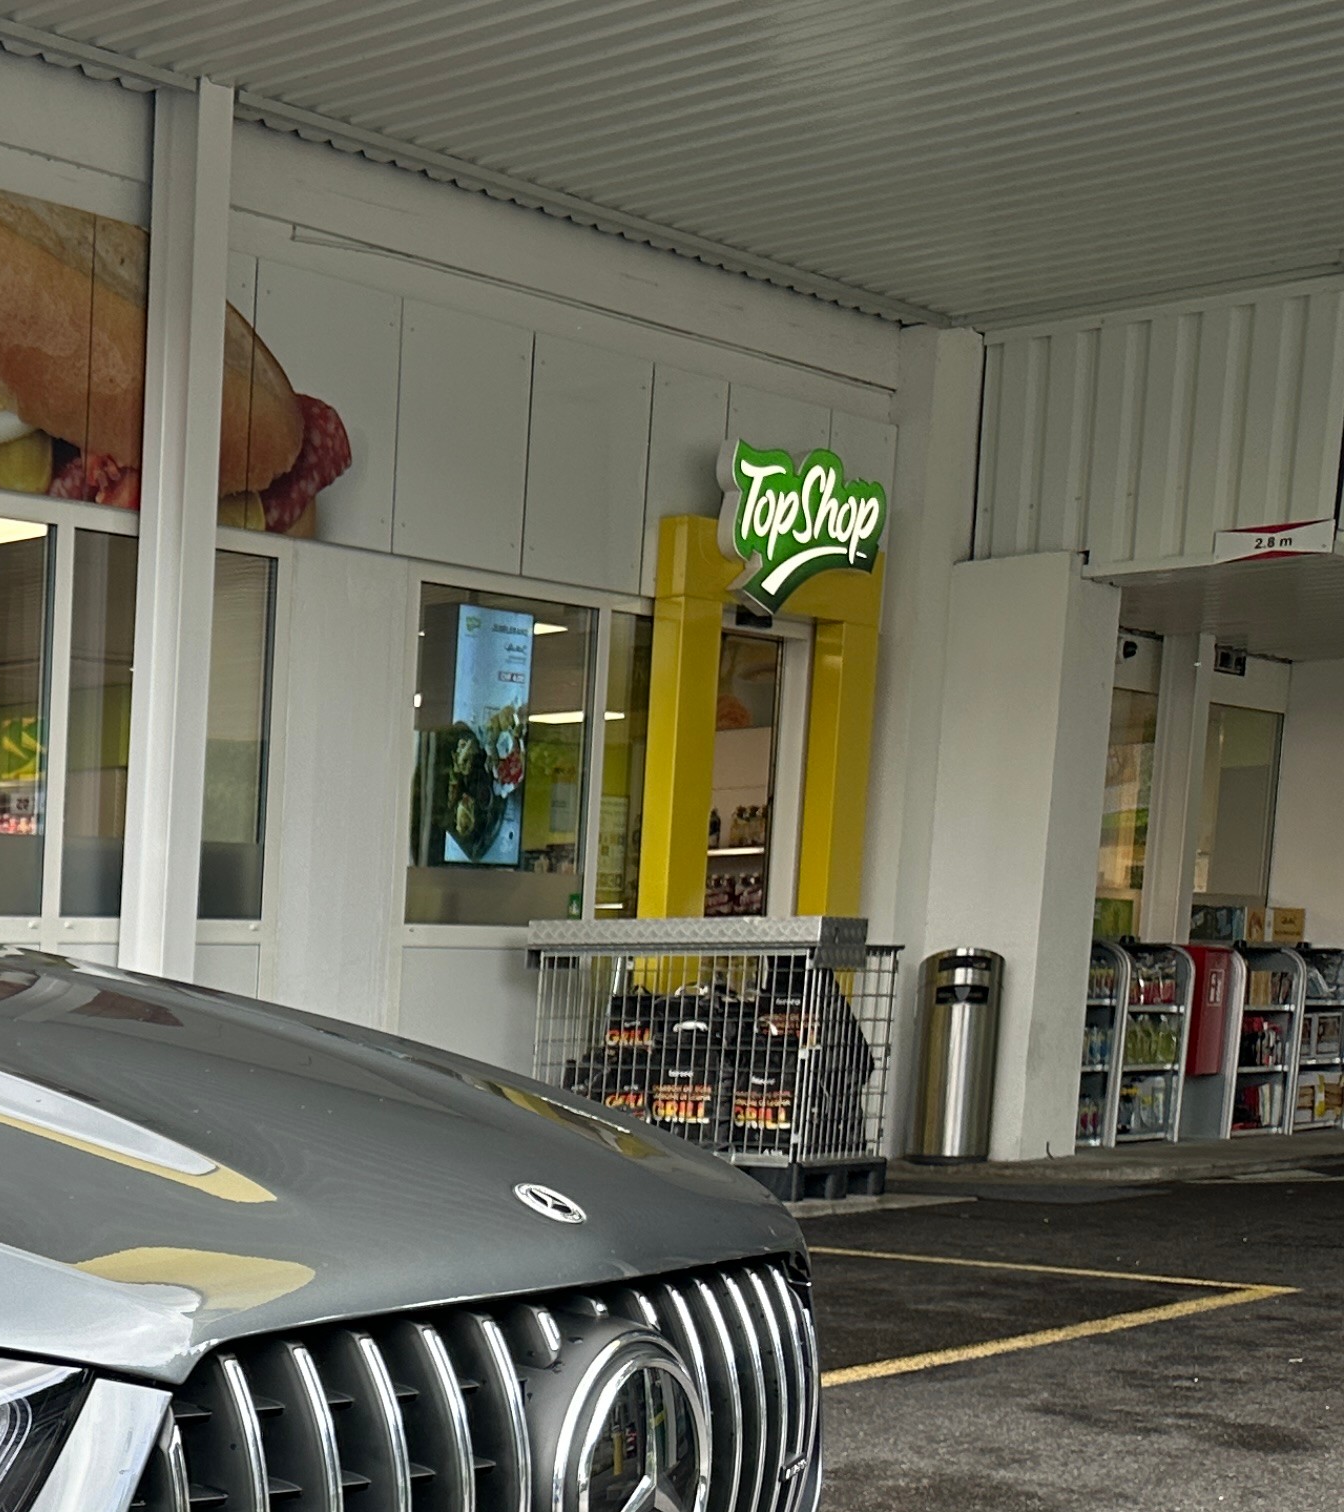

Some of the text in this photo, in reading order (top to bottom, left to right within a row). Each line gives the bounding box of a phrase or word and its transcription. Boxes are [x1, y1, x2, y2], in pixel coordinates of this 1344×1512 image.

[741, 459, 879, 564] TopShop
[1254, 537, 1293, 550] 2.8 m
[652, 1100, 711, 1123] GRILL
[734, 1106, 791, 1130] GRILL
